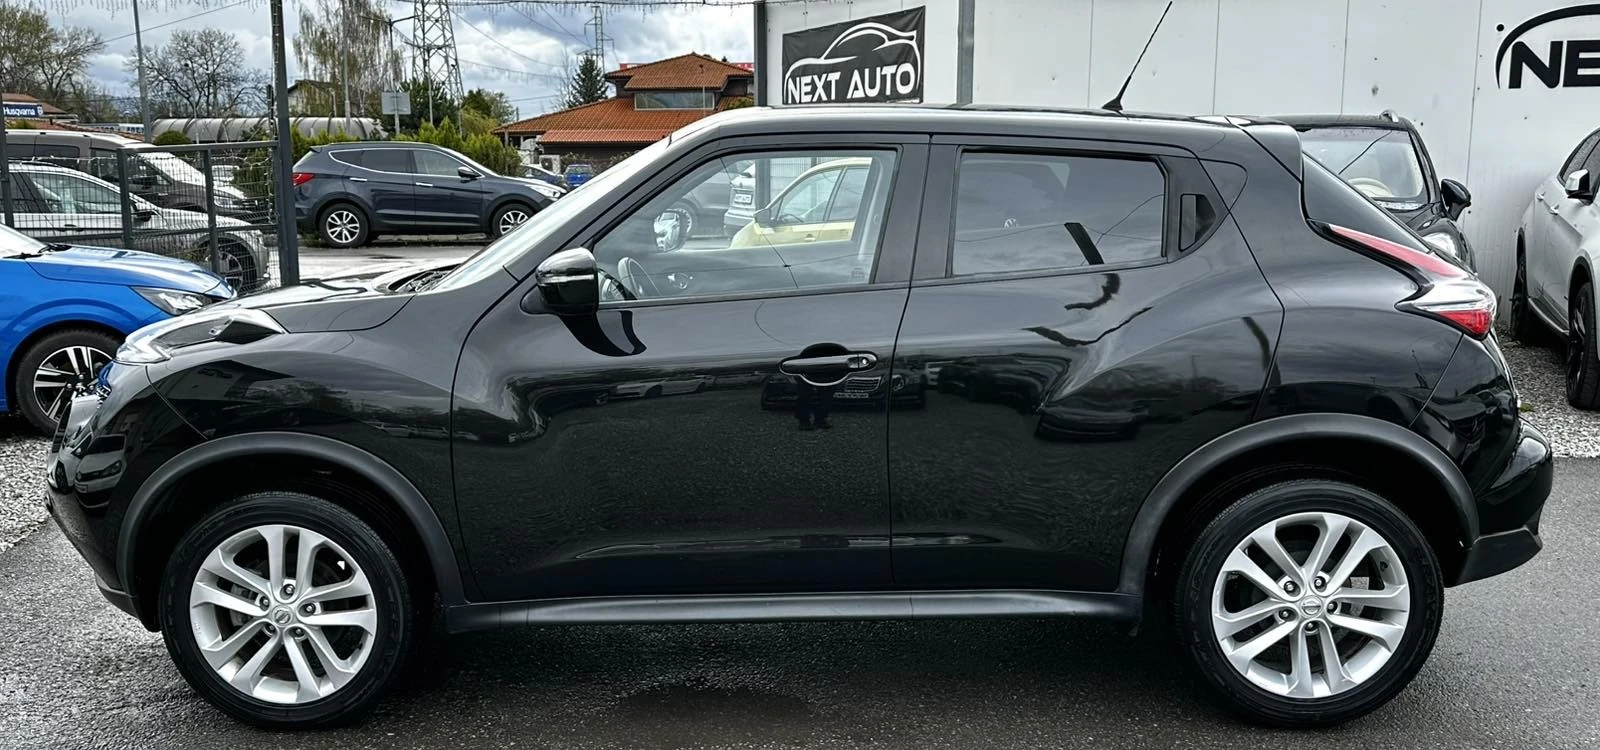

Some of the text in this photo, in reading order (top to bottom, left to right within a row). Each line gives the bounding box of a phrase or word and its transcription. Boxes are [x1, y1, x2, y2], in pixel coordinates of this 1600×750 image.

[787, 62, 916, 104] NEXT AUTO
[3, 106, 36, 116] Husqvarna
